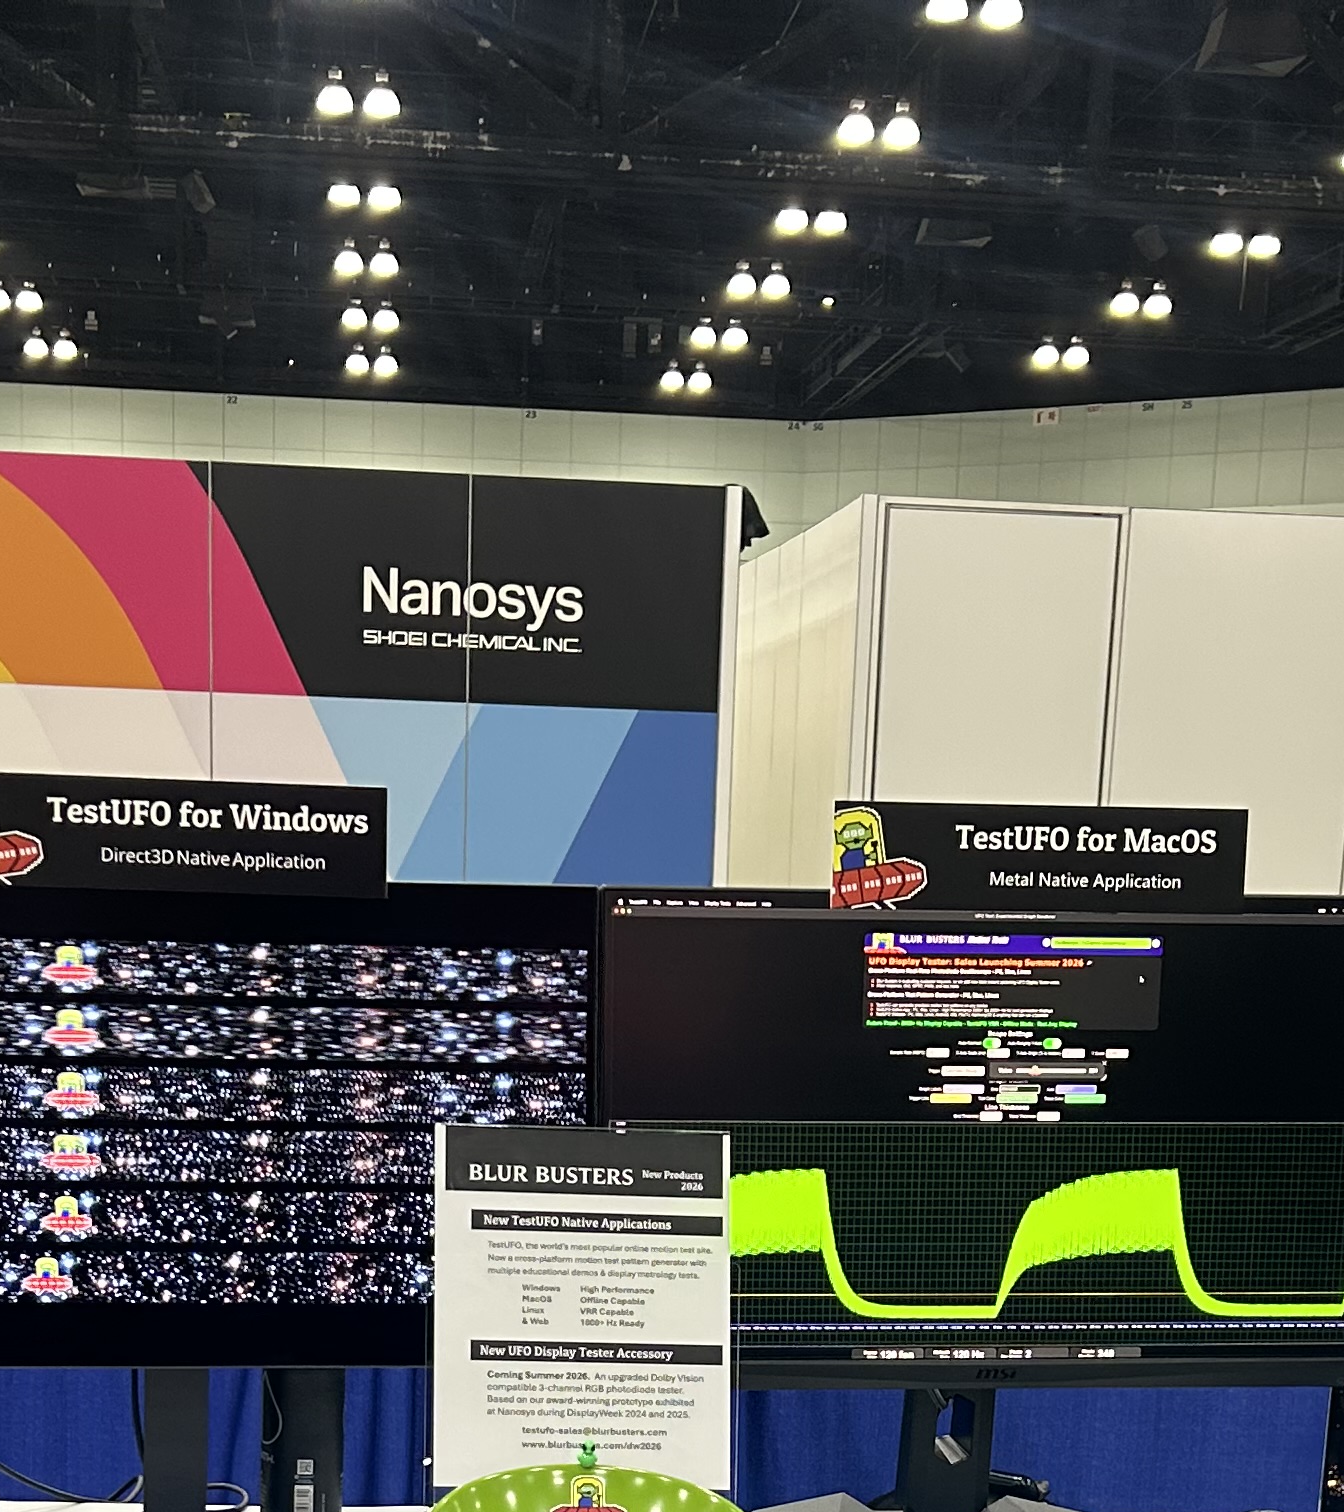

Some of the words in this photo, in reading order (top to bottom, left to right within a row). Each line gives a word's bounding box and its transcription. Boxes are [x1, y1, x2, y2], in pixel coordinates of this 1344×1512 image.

[363, 566, 583, 632] Nanosys
[363, 630, 427, 646] SHOEI
[432, 633, 541, 651] CHEMICAL
[544, 638, 582, 653] INC.
[47, 797, 171, 827] TestUFO
[179, 801, 222, 828] for
[229, 804, 369, 834] Windows
[956, 825, 1069, 851] TestUFO
[1077, 826, 1116, 852] for
[1123, 828, 1217, 854] MacOS
[101, 847, 173, 864] Direct3D
[177, 850, 230, 867] Native
[233, 852, 326, 871] Application
[989, 872, 1033, 887] Metal
[1039, 873, 1088, 888] Native
[1093, 873, 1181, 892] Application
[869, 957, 886, 967] UFO
[889, 957, 919, 968] Display
[979, 958, 1023, 968] Launching
[1025, 959, 1059, 967] Summer
[1062, 959, 1084, 967] 2026
[469, 1164, 528, 1182] BLUR
[535, 1166, 634, 1186] BUSTERS
[642, 1170, 661, 1179] New
[664, 1171, 703, 1180] Products
[681, 1182, 704, 1191] 2026
[483, 1214, 509, 1226] New
[512, 1215, 559, 1227] TestUFO
[562, 1217, 598, 1228] Native
[601, 1218, 671, 1231] Applications
[580, 1286, 599, 1294] High
[611, 1298, 645, 1306] Capable
[619, 1320, 644, 1328] Ready
[480, 1345, 505, 1356] New
[508, 1346, 531, 1356] UFO
[534, 1346, 577, 1359] Display
[578, 1347, 613, 1359] Tester
[616, 1348, 673, 1361] Accessory
[487, 1371, 523, 1380] Coming
[525, 1371, 564, 1379] Summer
[608, 1373, 648, 1382] upgraded
[651, 1374, 676, 1383] Dolby
[487, 1384, 537, 1393] compatible
[539, 1384, 582, 1392] 3-channel
[585, 1385, 604, 1393] RGB
[606, 1385, 655, 1394] photodiode
[487, 1395, 514, 1403] Based
[547, 1396, 610, 1406] award-winning
[612, 1398, 654, 1407] prototype
[656, 1399, 694, 1407] exhibited
[498, 1408, 536, 1417] Nanosys
[537, 1409, 565, 1418] during
[648, 1410, 664, 1418] and
